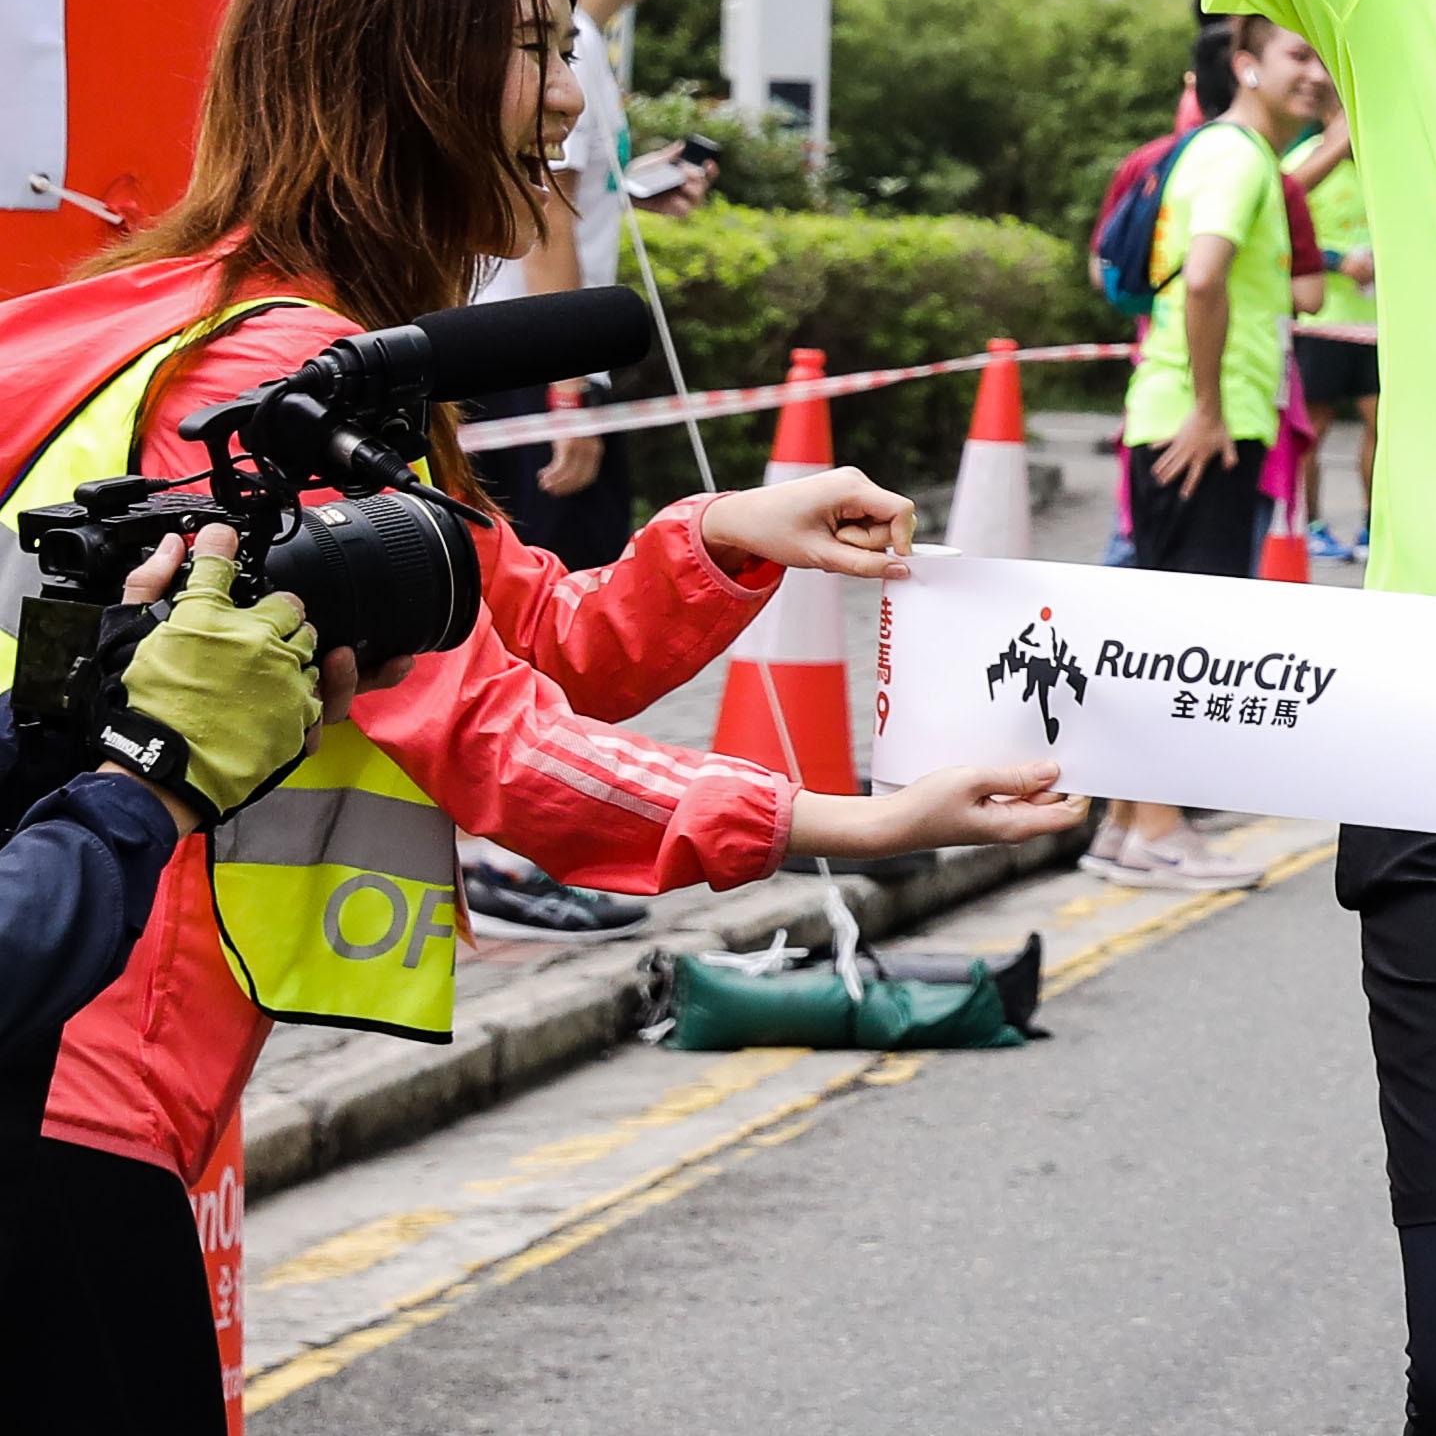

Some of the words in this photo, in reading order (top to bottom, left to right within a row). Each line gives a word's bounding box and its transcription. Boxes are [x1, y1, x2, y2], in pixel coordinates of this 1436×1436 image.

[1094, 638, 1338, 706] RunOurCity
[1171, 690, 1302, 730] 全城街馬
